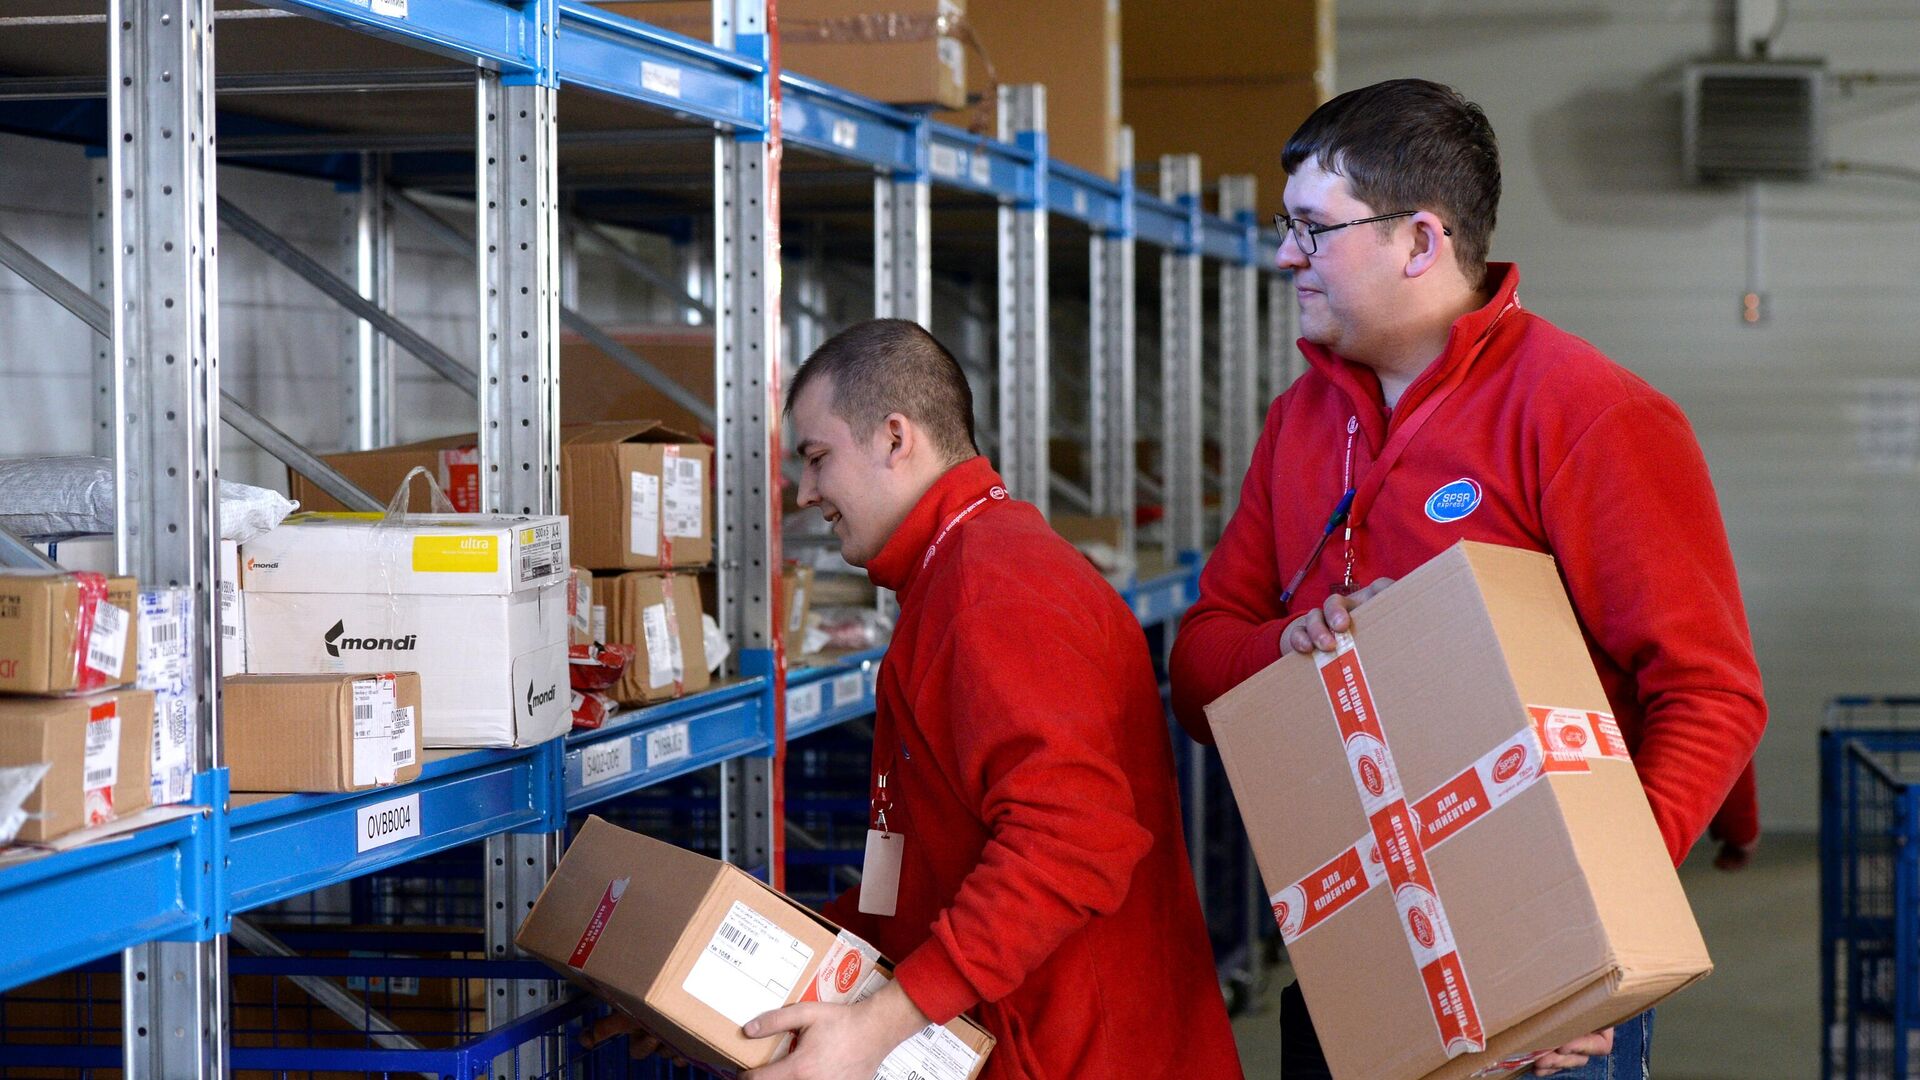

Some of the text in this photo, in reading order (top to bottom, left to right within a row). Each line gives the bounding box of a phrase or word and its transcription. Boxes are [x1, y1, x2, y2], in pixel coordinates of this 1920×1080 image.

[1437, 501, 1465, 509] express
[1442, 492, 1470, 503] SPSR
[552, 524, 559, 538] A4
[460, 538, 489, 549] ultra
[341, 634, 417, 651] mondi
[533, 684, 556, 707] mondi
[1337, 687, 1352, 713] ДЛЯ
[1342, 665, 1367, 722] КЛИЕНТОВ
[1499, 752, 1520, 771] SPSR
[1437, 792, 1459, 814] ДЛЯ
[368, 805, 411, 839] OVBB004
[1428, 796, 1477, 835] КЛИЕНТОВ
[1385, 838, 1401, 863] ДЛЯ
[1390, 815, 1416, 872] КЛИЕНТОВ
[1321, 870, 1341, 892] ДЛЯ
[1313, 876, 1357, 911] КЛИЕНТОВ
[1437, 990, 1452, 1017] ДЛЯ
[1443, 968, 1469, 1027] КЛИЕНТОВ
